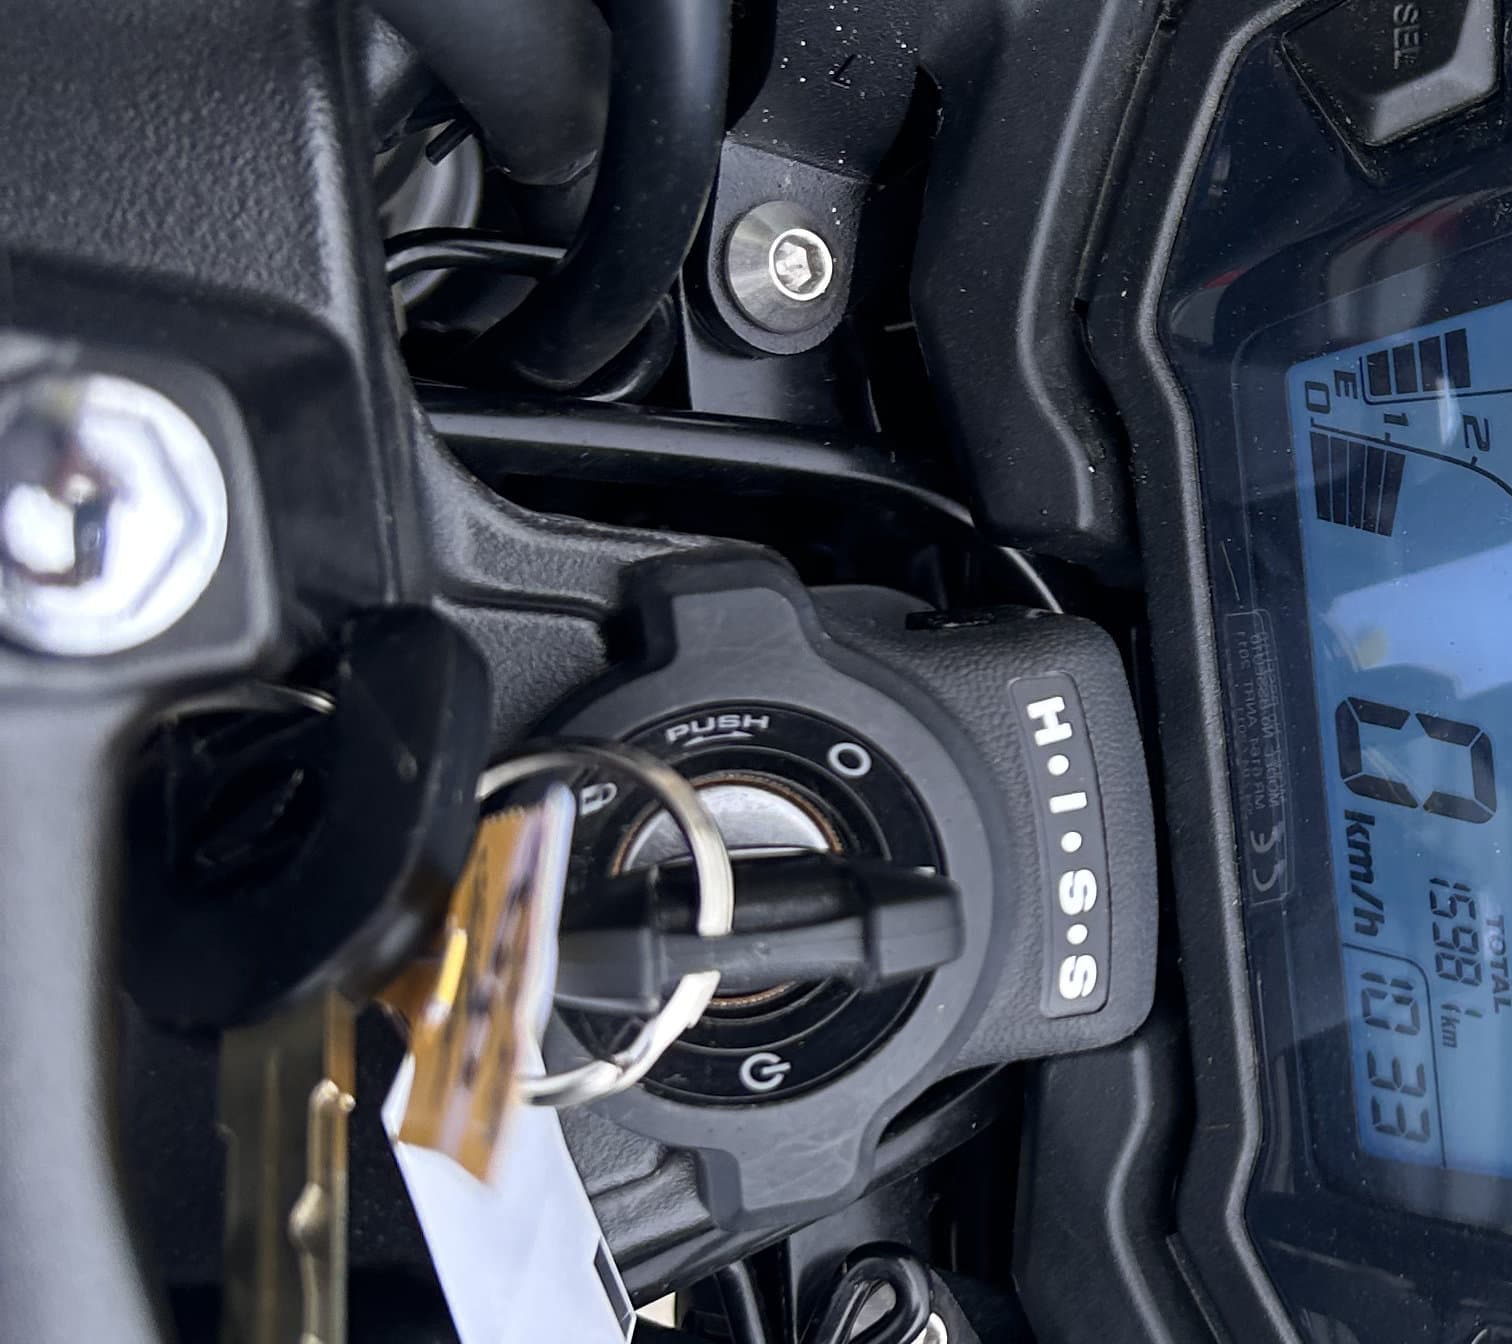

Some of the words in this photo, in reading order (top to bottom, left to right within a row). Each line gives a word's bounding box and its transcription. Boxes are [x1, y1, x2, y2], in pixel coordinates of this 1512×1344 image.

[1392, 4, 1422, 70] SEL
[1304, 381, 1331, 414] 0
[1334, 370, 1358, 399] E
[1384, 413, 1408, 426] 1
[1463, 414, 1490, 452] 2
[665, 714, 770, 743] PUSH
[1335, 696, 1497, 824] 0
[1344, 810, 1385, 936] km/h
[1486, 915, 1512, 1013] TOTAL
[1440, 1016, 1458, 1048] km
